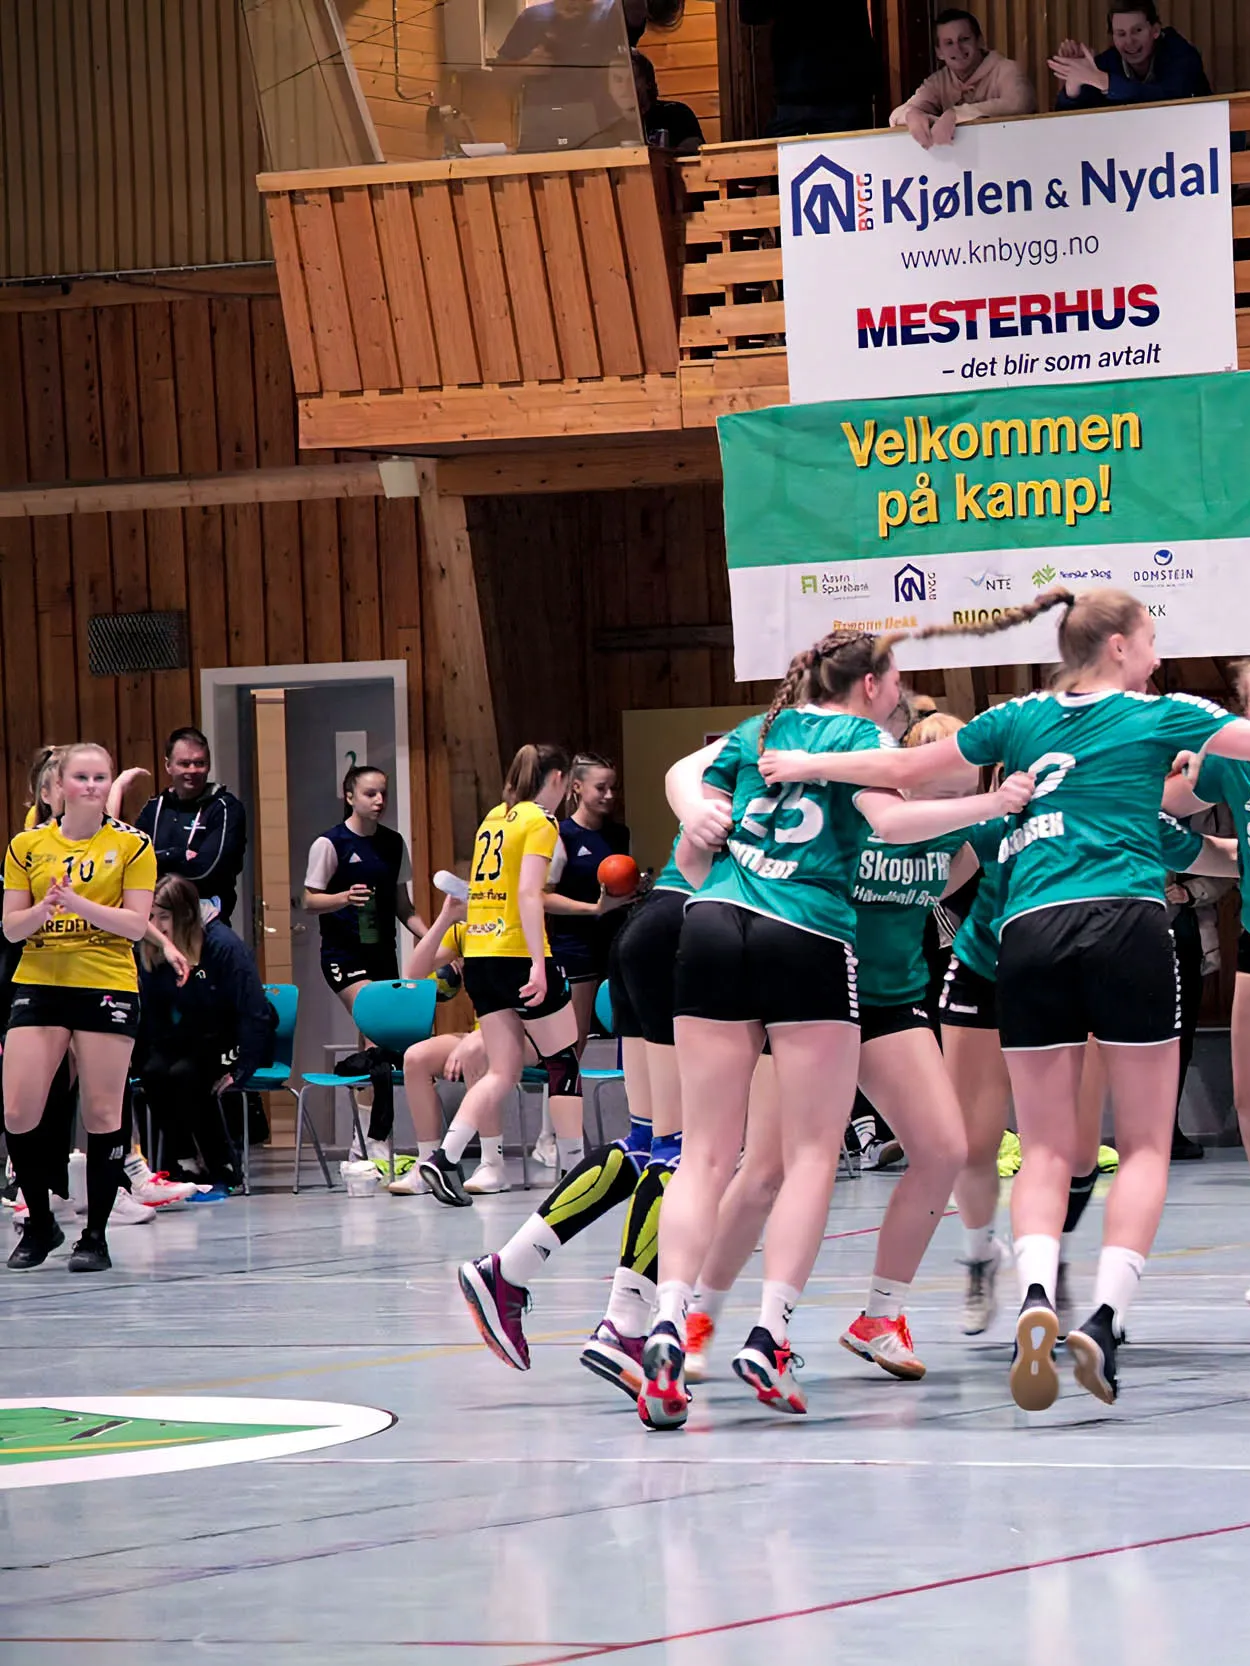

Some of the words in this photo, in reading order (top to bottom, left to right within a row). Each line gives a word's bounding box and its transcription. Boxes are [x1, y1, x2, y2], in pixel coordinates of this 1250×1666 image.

[858, 172, 874, 232] BYGG
[882, 170, 1033, 232] Kjølen
[1045, 178, 1070, 210] &
[1080, 146, 1220, 213] Nydal
[900, 233, 1100, 270] www.knbygg.no
[856, 283, 1160, 349] MESTERHUS
[961, 355, 996, 379] det
[1003, 352, 1040, 377] blir
[1044, 352, 1092, 373] som
[1098, 342, 1162, 368] avtalt
[840, 412, 1141, 467] Velkommen
[878, 471, 939, 540] på
[955, 464, 1111, 526] kamp!
[985, 577, 1012, 591] NTE
[1133, 568, 1194, 582] DOMSTEIN
[61, 855, 95, 883] 10
[475, 828, 504, 882] 23
